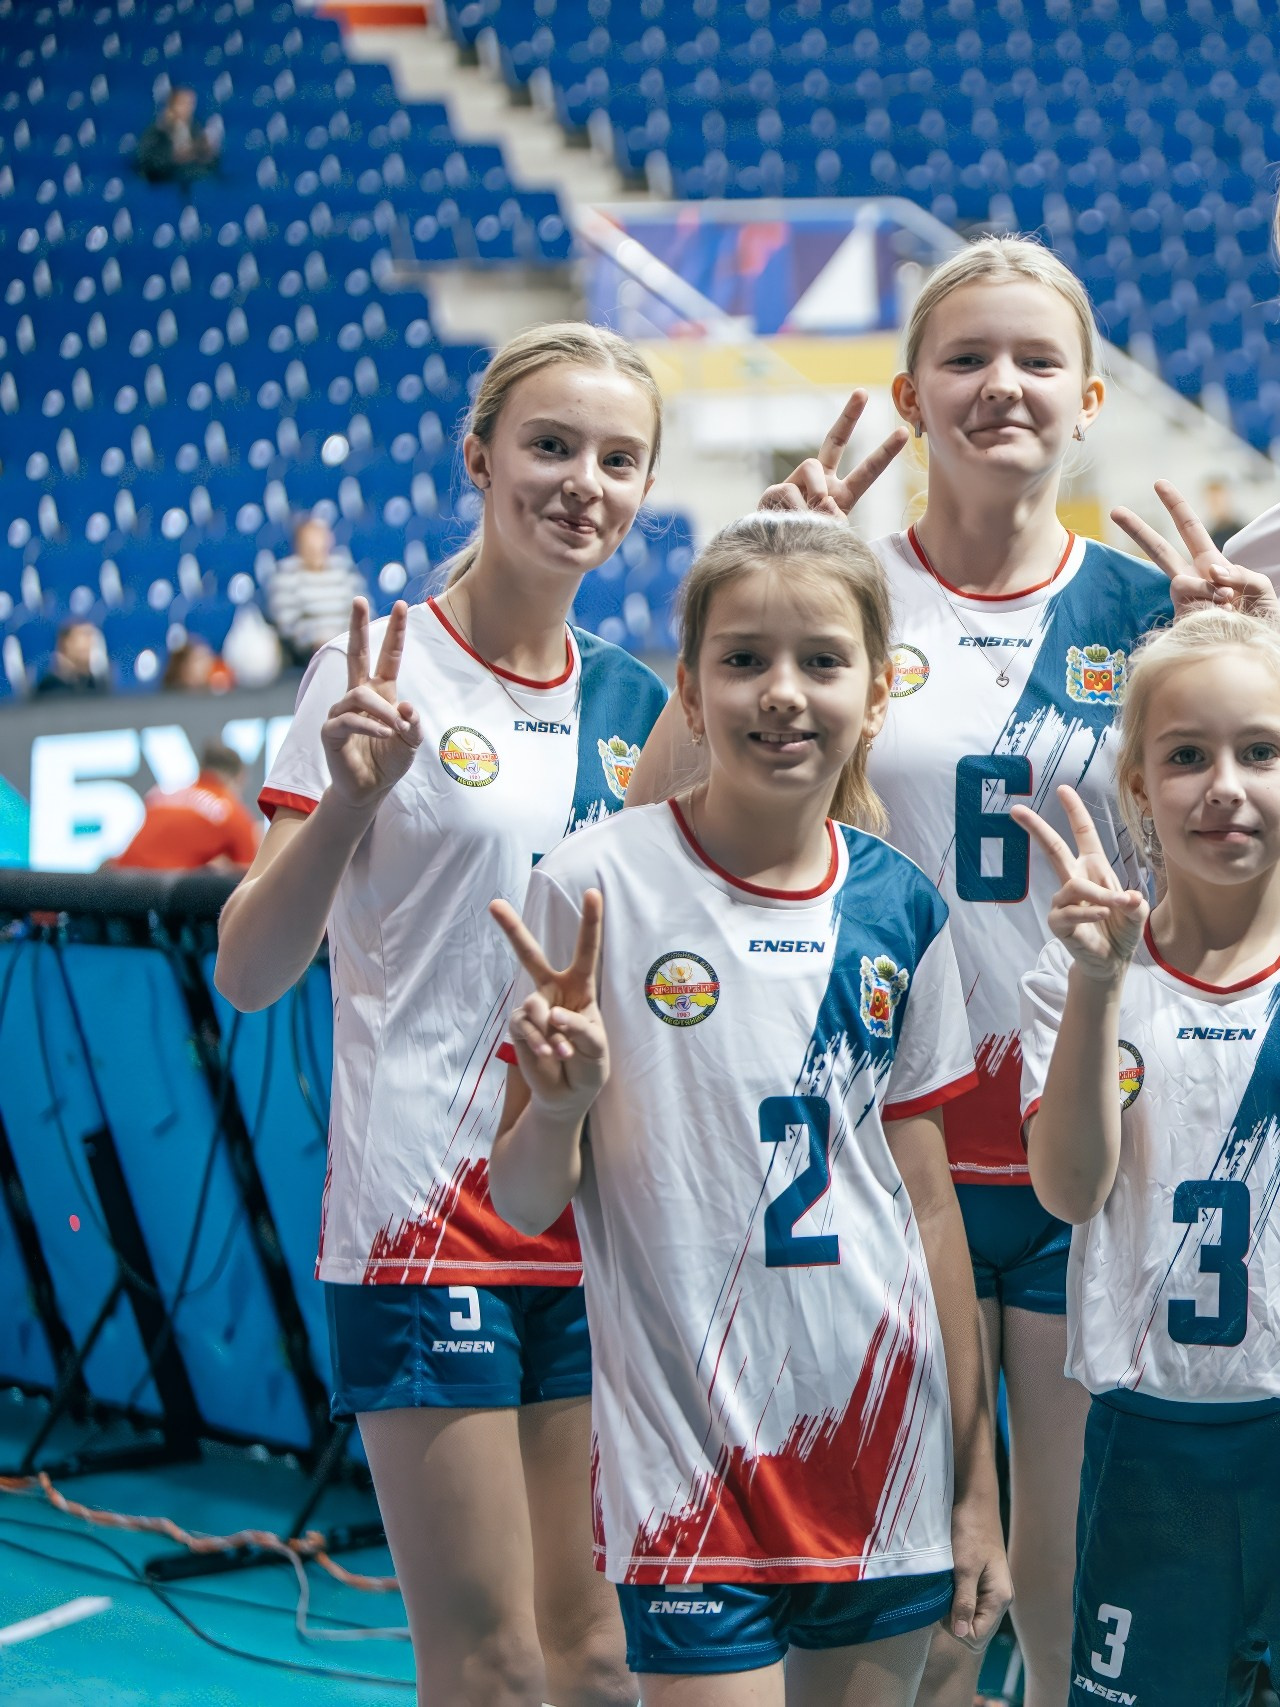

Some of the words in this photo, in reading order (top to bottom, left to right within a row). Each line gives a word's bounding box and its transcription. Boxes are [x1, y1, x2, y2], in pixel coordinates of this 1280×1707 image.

[957, 636, 1034, 648] ENSEN
[513, 720, 572, 736] ENSEN
[955, 754, 1033, 904] 6
[748, 939, 826, 953] ENSEN
[1176, 1026, 1257, 1042] ENSEN
[758, 1095, 841, 1268] 2
[1167, 1179, 1252, 1347] 3
[431, 1340, 495, 1354] ENSEN
[647, 1600, 724, 1615] ENSEN
[1090, 1602, 1133, 1680] 3
[1073, 1673, 1138, 1707] ENSEN
